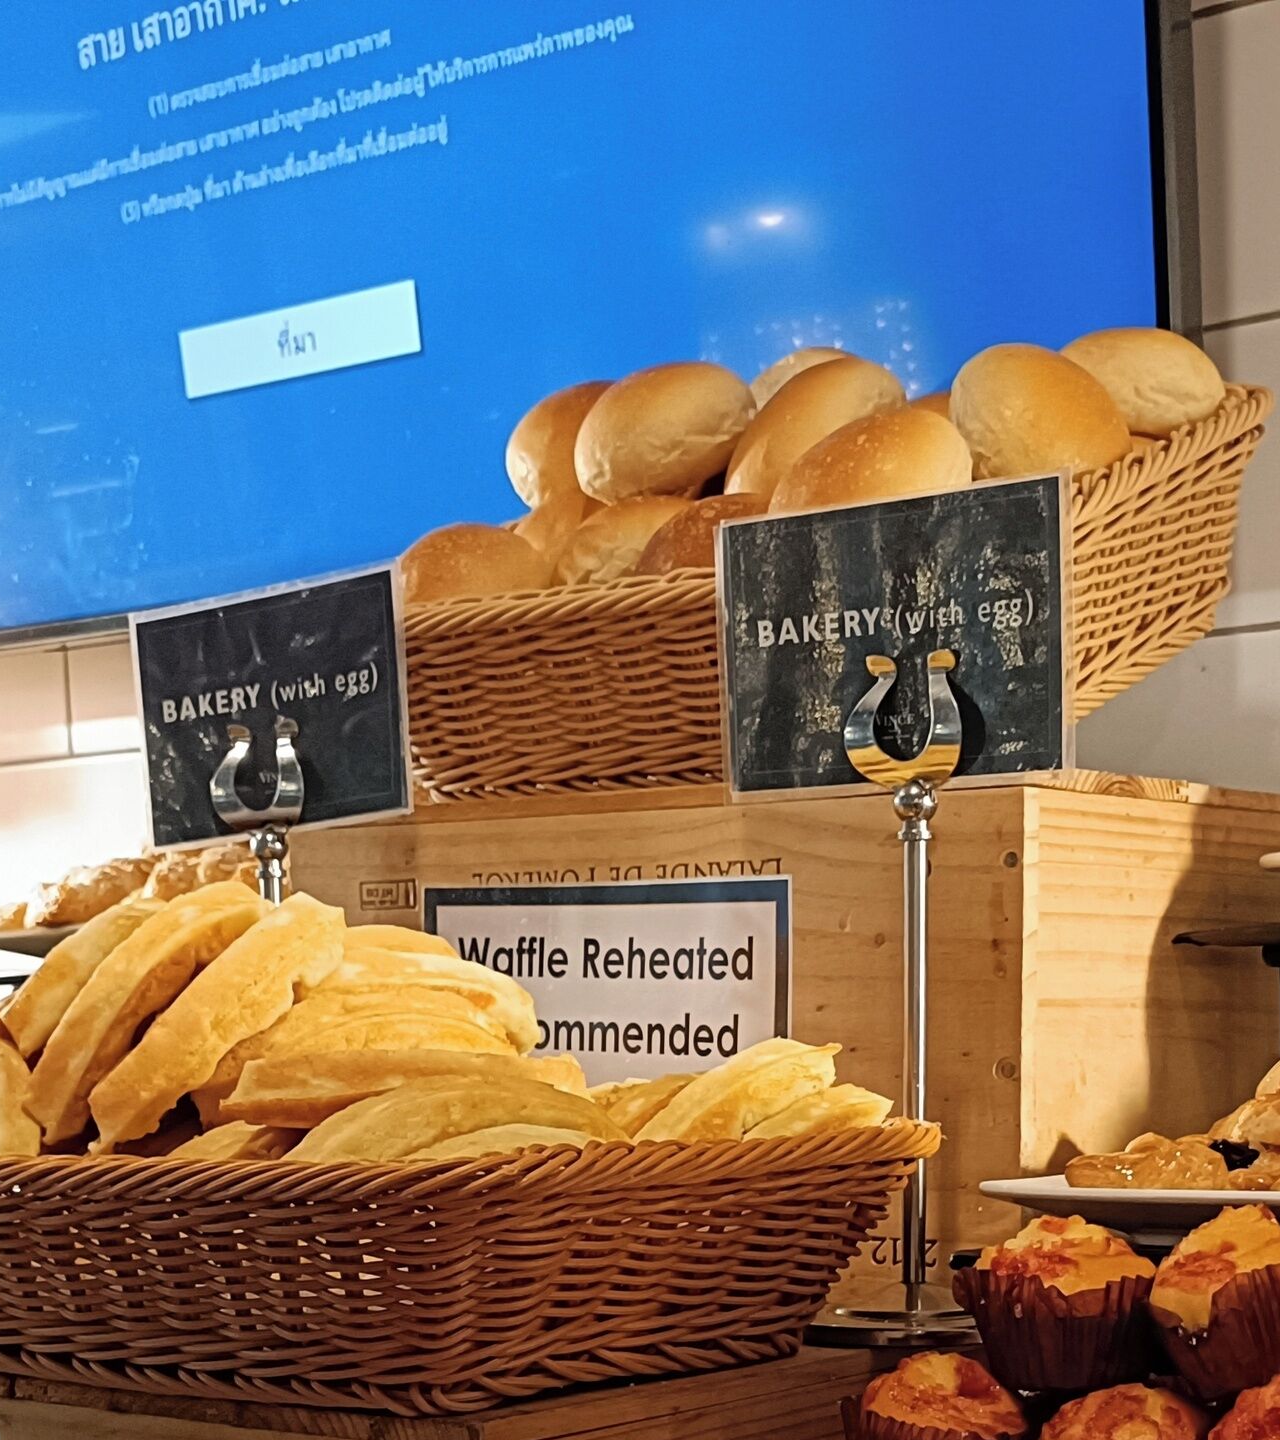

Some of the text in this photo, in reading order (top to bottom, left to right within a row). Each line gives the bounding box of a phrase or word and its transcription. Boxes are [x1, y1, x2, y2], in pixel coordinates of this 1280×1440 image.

[77, 26, 126, 70] สาย
[277, 319, 317, 358] ที่มา
[757, 589, 1034, 648] BAKERY (with egg)
[161, 661, 378, 723] BAKERY (with egg)
[458, 936, 754, 981] Waffle Reheated
[534, 1012, 739, 1058] ommended
[871, 1236, 938, 1267] 212
